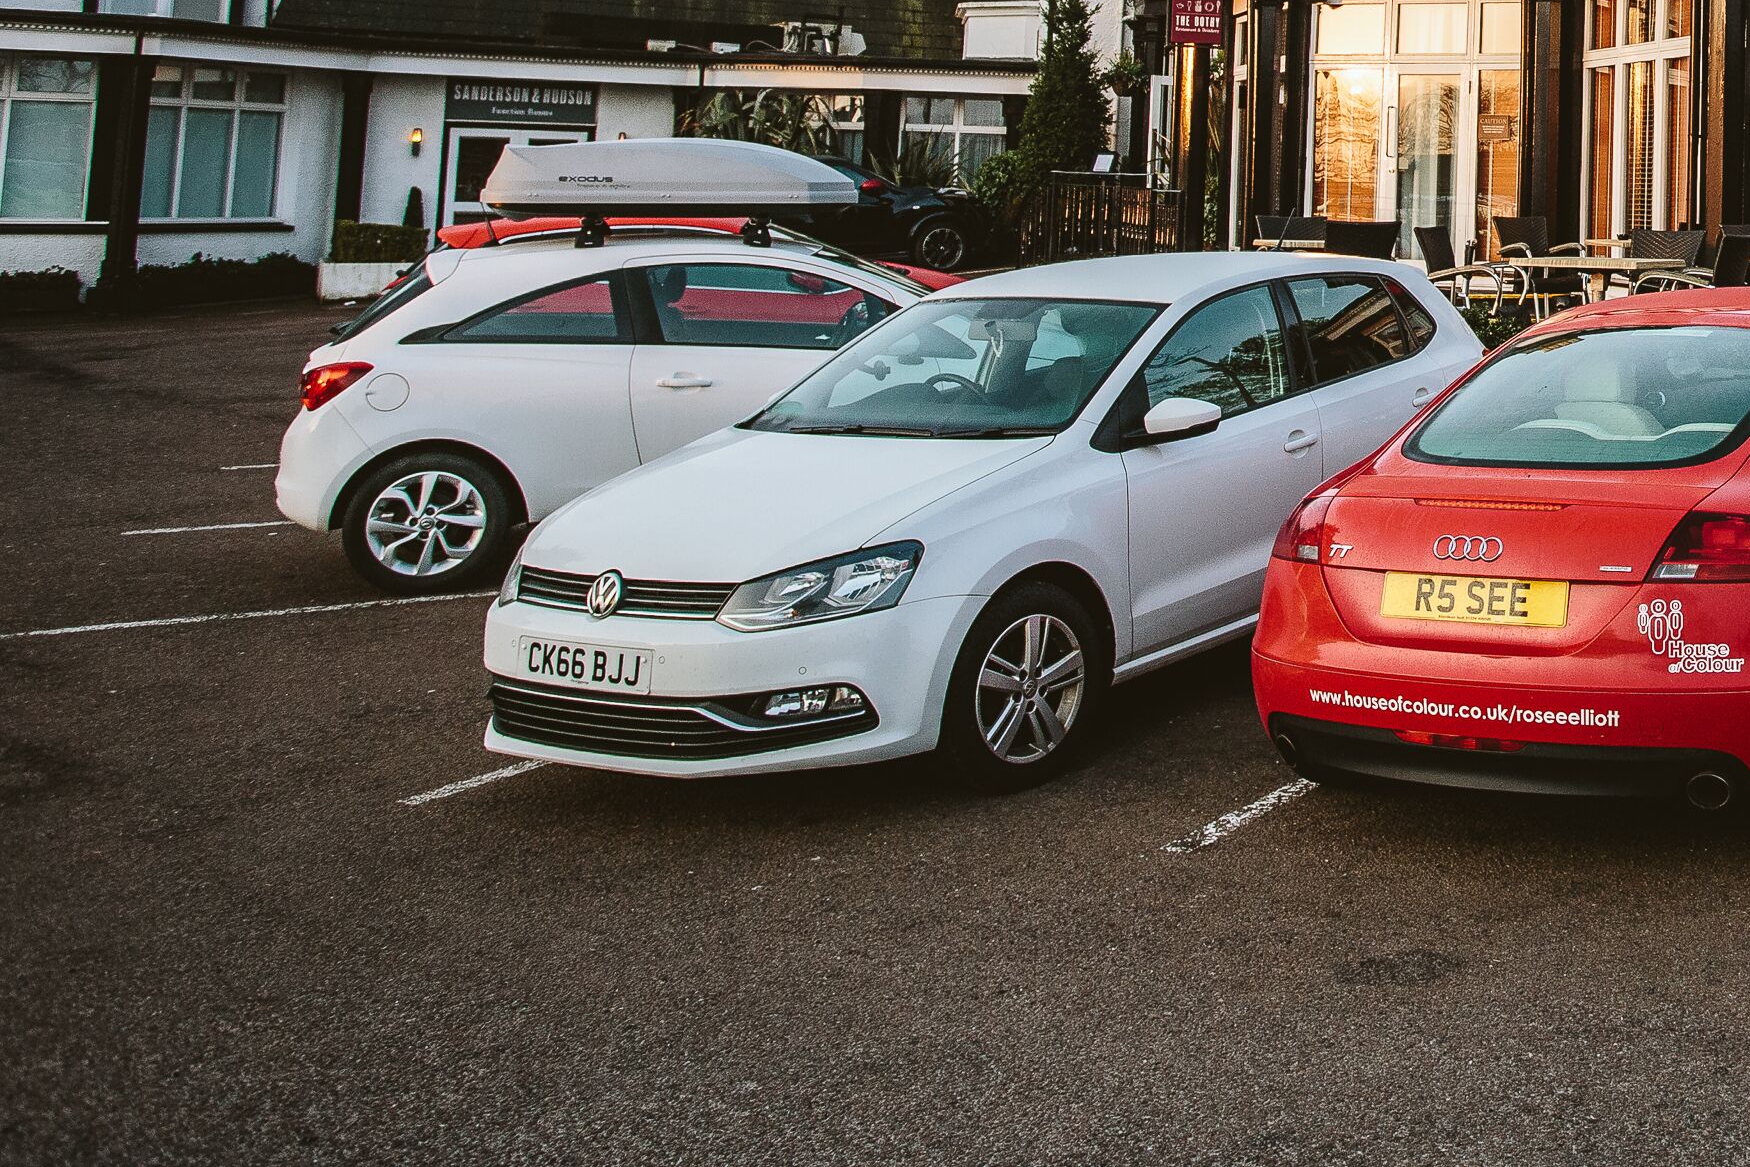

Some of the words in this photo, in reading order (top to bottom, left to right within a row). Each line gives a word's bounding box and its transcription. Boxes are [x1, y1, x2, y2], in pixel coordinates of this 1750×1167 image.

[1175, 15, 1190, 26] THE
[1194, 16, 1220, 28] BOTHY
[453, 84, 529, 102] SANDERSON
[531, 88, 541, 103] &
[543, 88, 593, 105] HUDSON
[558, 175, 614, 183] exodus
[1328, 543, 1354, 558] TT
[1415, 577, 1456, 614] R5
[1466, 580, 1532, 617] SEE
[1668, 640, 1730, 658] House
[528, 641, 586, 679] CK66
[591, 650, 642, 687] BJJ
[1668, 662, 1682, 673] of
[1681, 656, 1745, 673] Colour
[1309, 688, 1620, 728] www.houseofcolour.co.uk/roseeelliott
